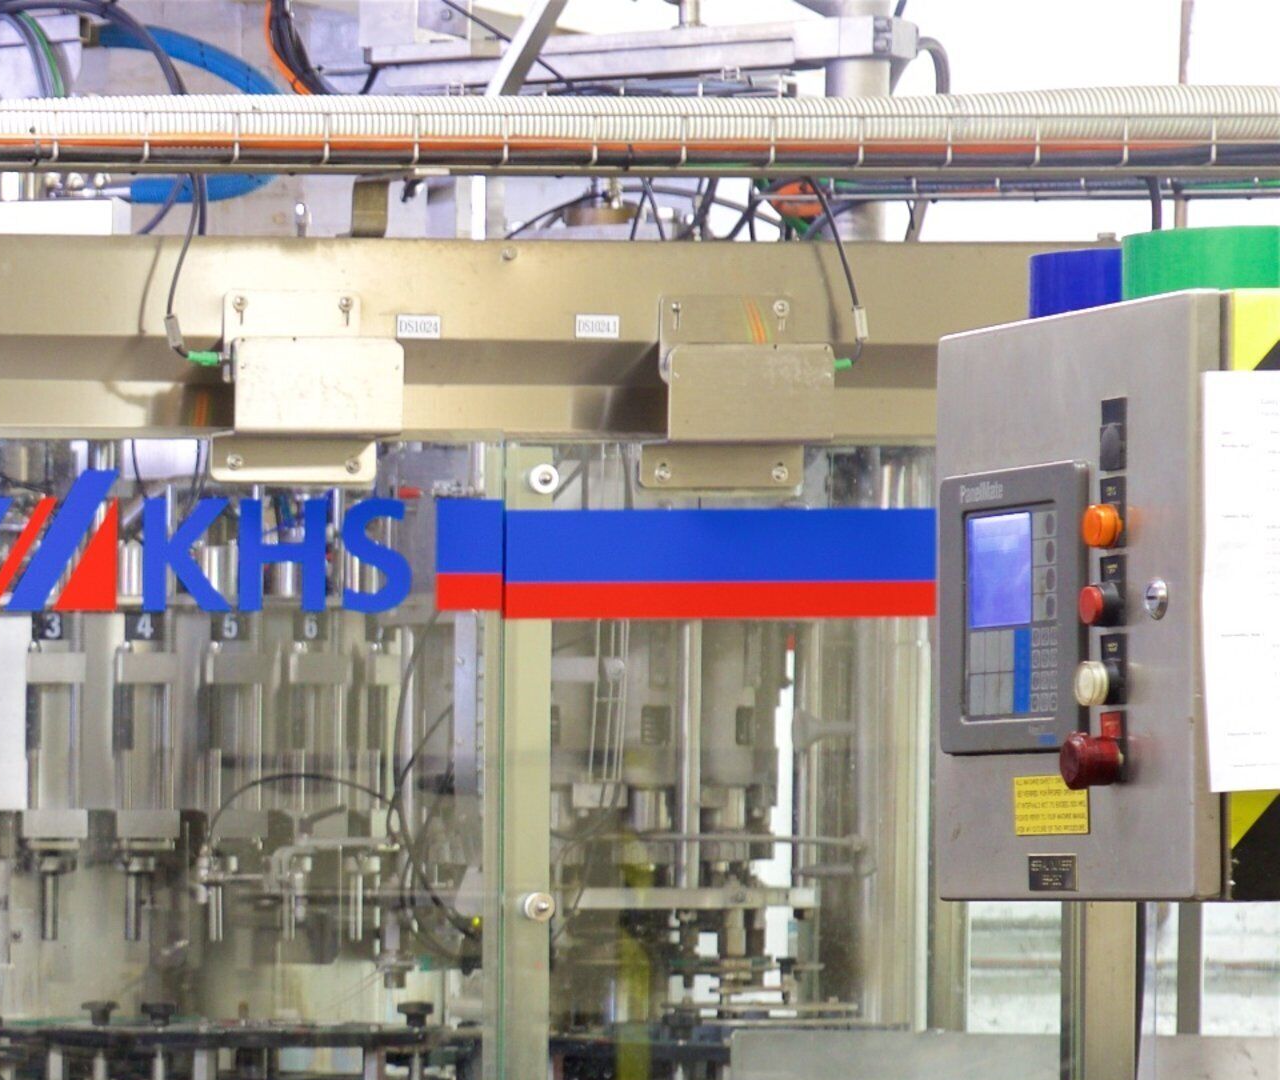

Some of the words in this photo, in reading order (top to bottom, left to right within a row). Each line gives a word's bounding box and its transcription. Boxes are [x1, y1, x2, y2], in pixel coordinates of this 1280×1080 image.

[399, 319, 439, 334] DS1024
[959, 481, 1003, 504] PanelMate
[142, 497, 413, 614] KHS
[45, 614, 62, 638] 3
[136, 614, 154, 638] 4
[222, 615, 238, 638] 5
[303, 615, 319, 638] 6
